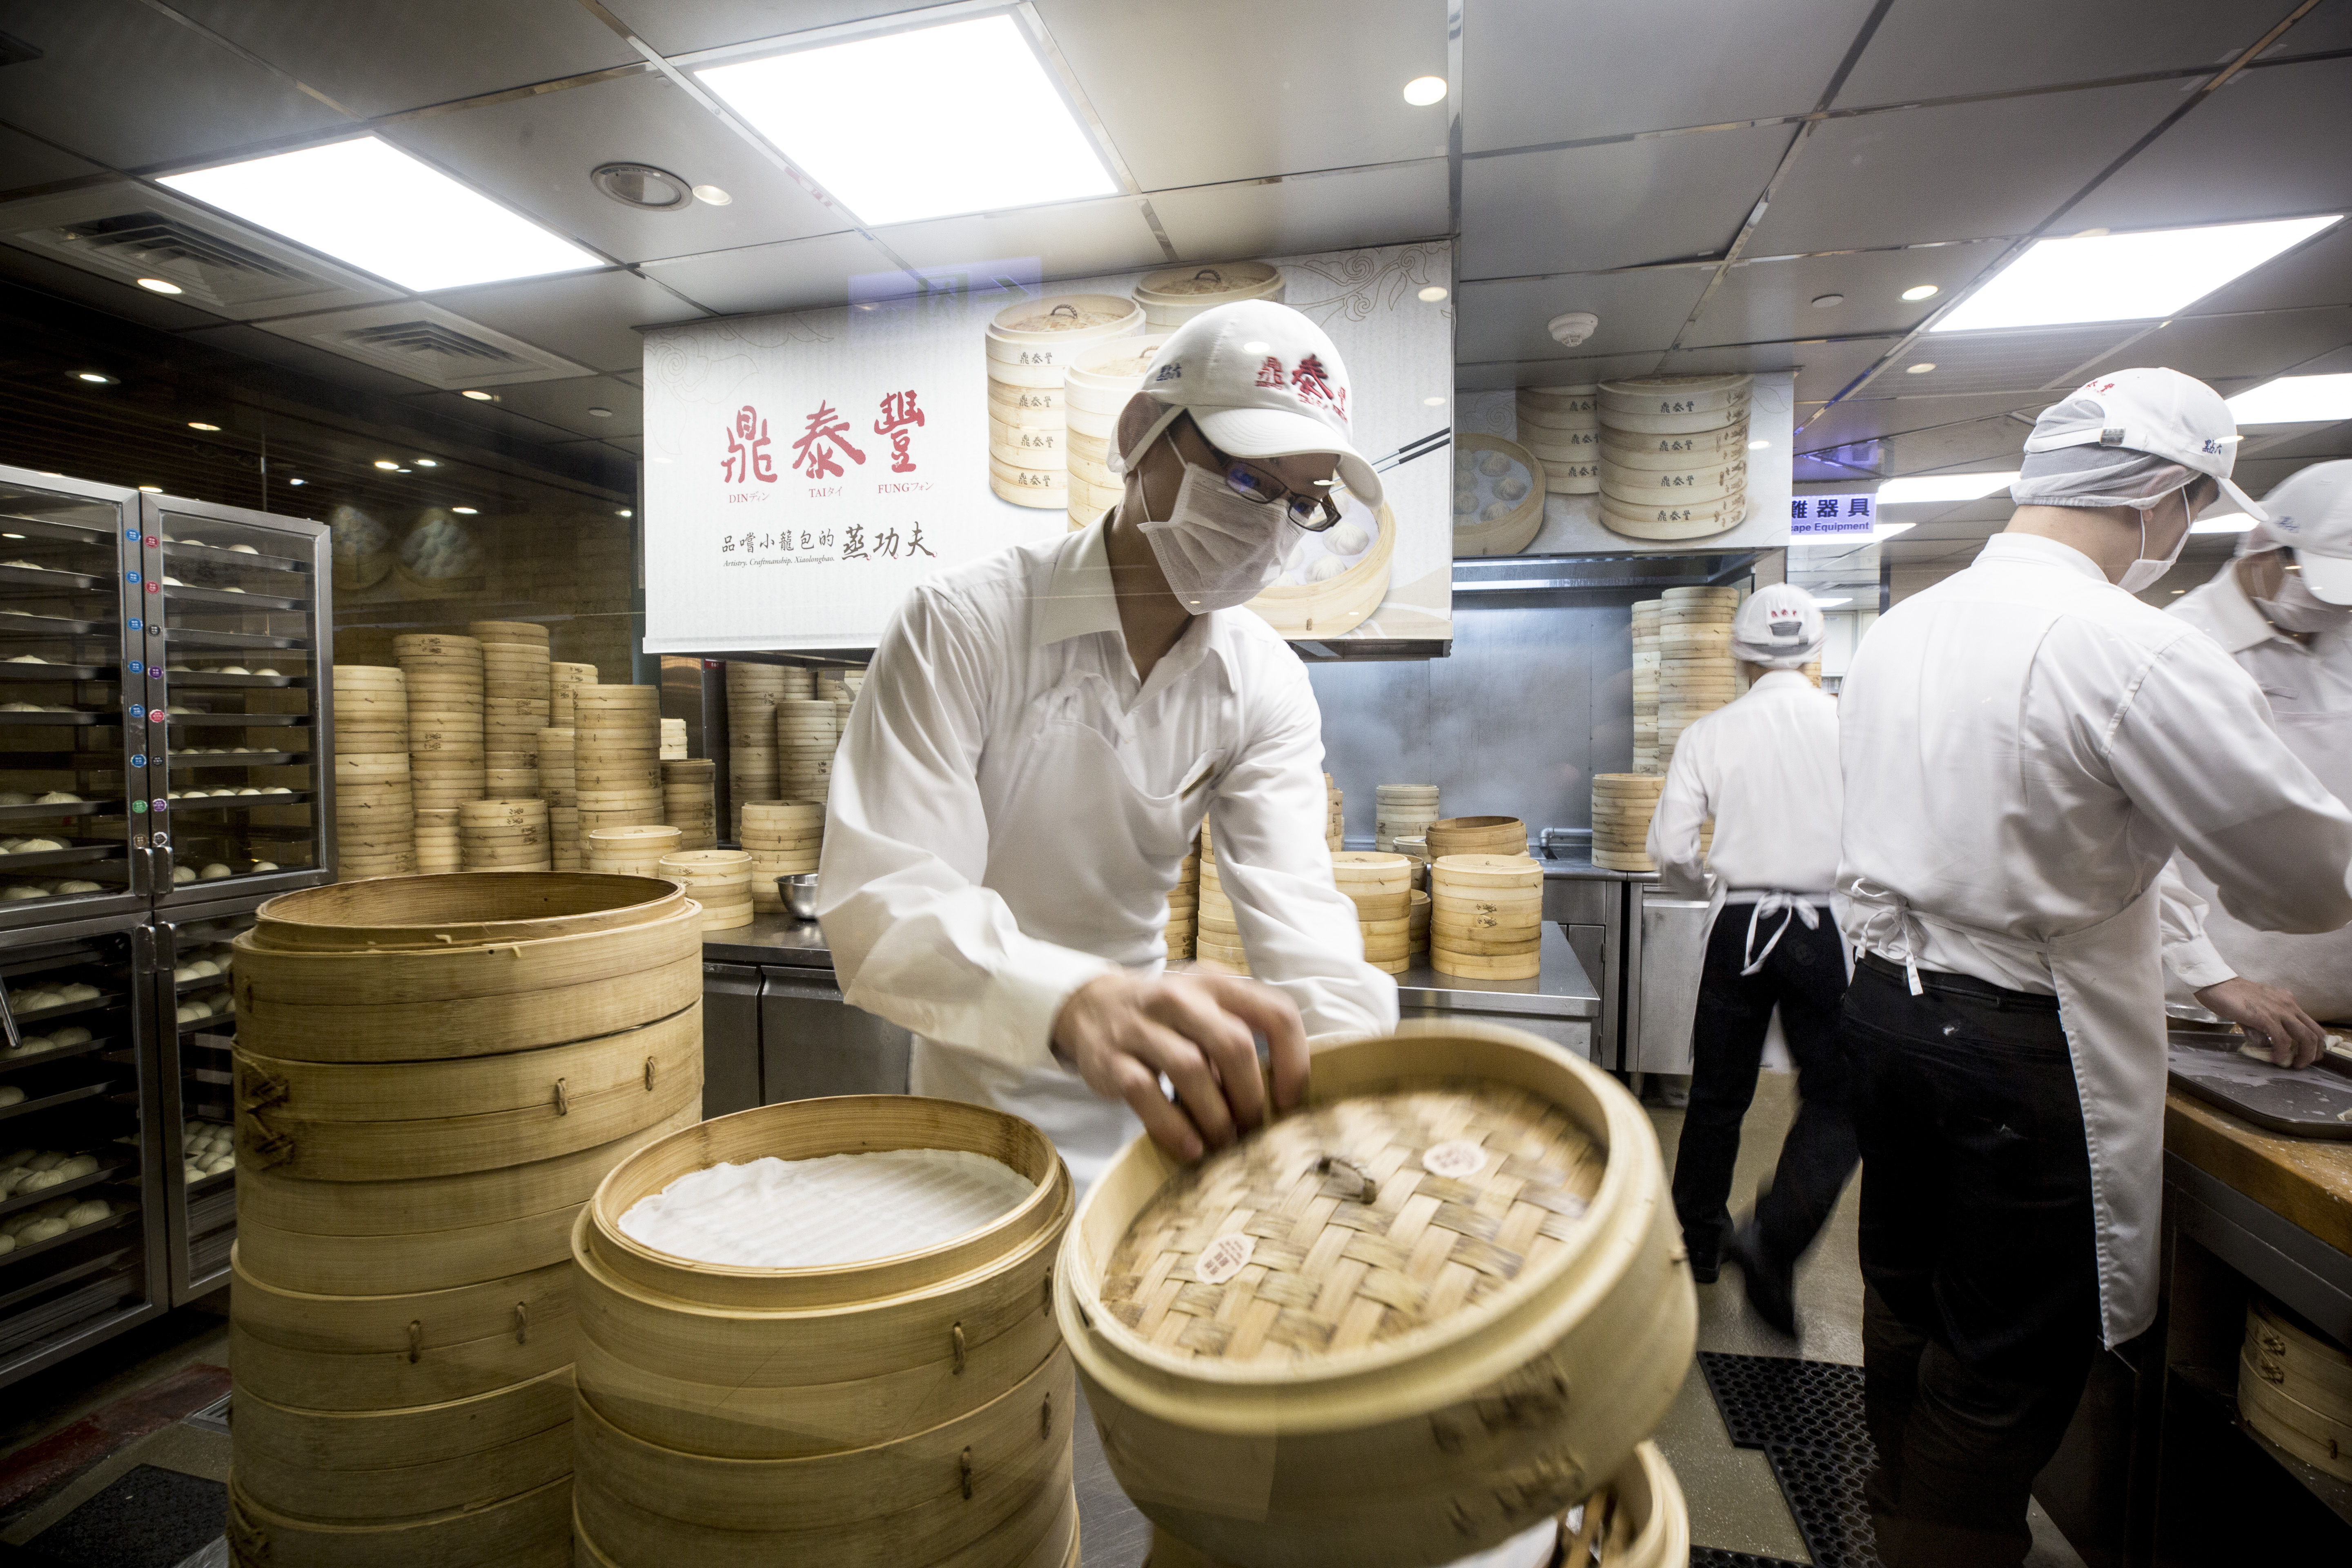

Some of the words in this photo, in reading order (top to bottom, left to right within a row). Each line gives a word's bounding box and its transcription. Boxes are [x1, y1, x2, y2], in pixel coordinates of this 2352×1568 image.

[1020, 352, 1052, 364] 鼎泰豐
[1019, 394, 1051, 408] 鼎泰豐
[721, 390, 925, 483] 鼎泰豐
[1021, 434, 1053, 448] 鼎泰豐
[1018, 472, 1050, 487] 鼎泰豐
[1815, 522, 1869, 532] Equipment
[723, 559, 747, 568] Artistry.
[750, 557, 792, 567] Craftmanship.
[794, 555, 835, 564] Xiaolongbao.
